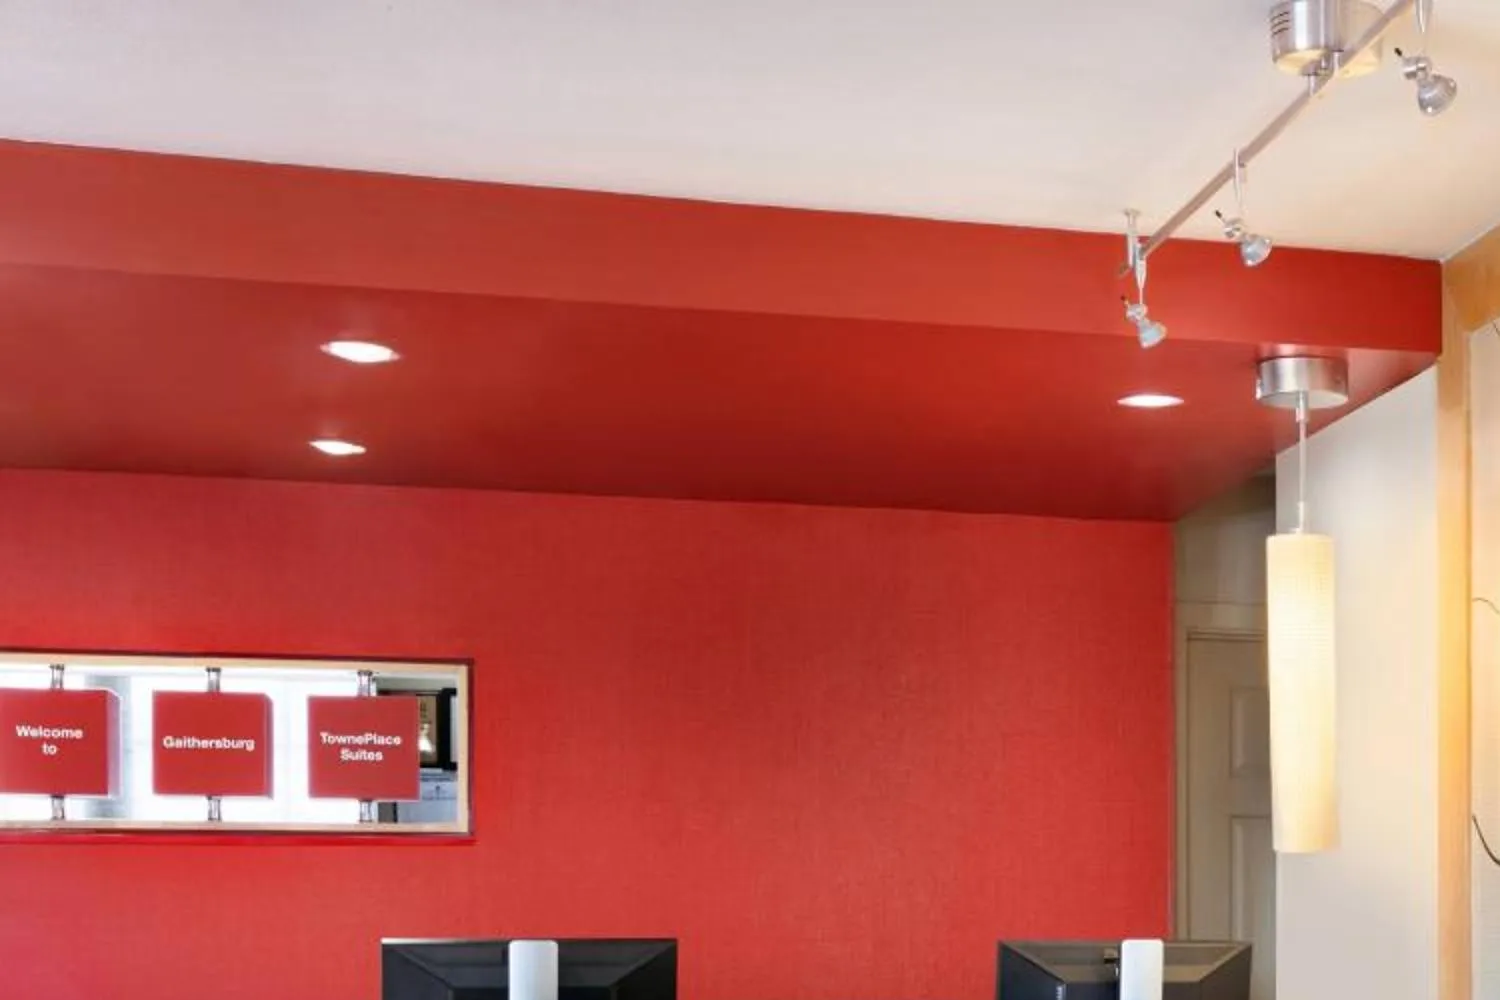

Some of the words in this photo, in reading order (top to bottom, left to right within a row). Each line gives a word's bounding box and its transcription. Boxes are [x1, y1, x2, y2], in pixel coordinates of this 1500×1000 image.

[15, 725, 84, 740] Welcome
[319, 731, 402, 747] TownePlace
[42, 742, 58, 755] to
[162, 735, 256, 753] Gaithersburg
[340, 748, 384, 762] Suites
